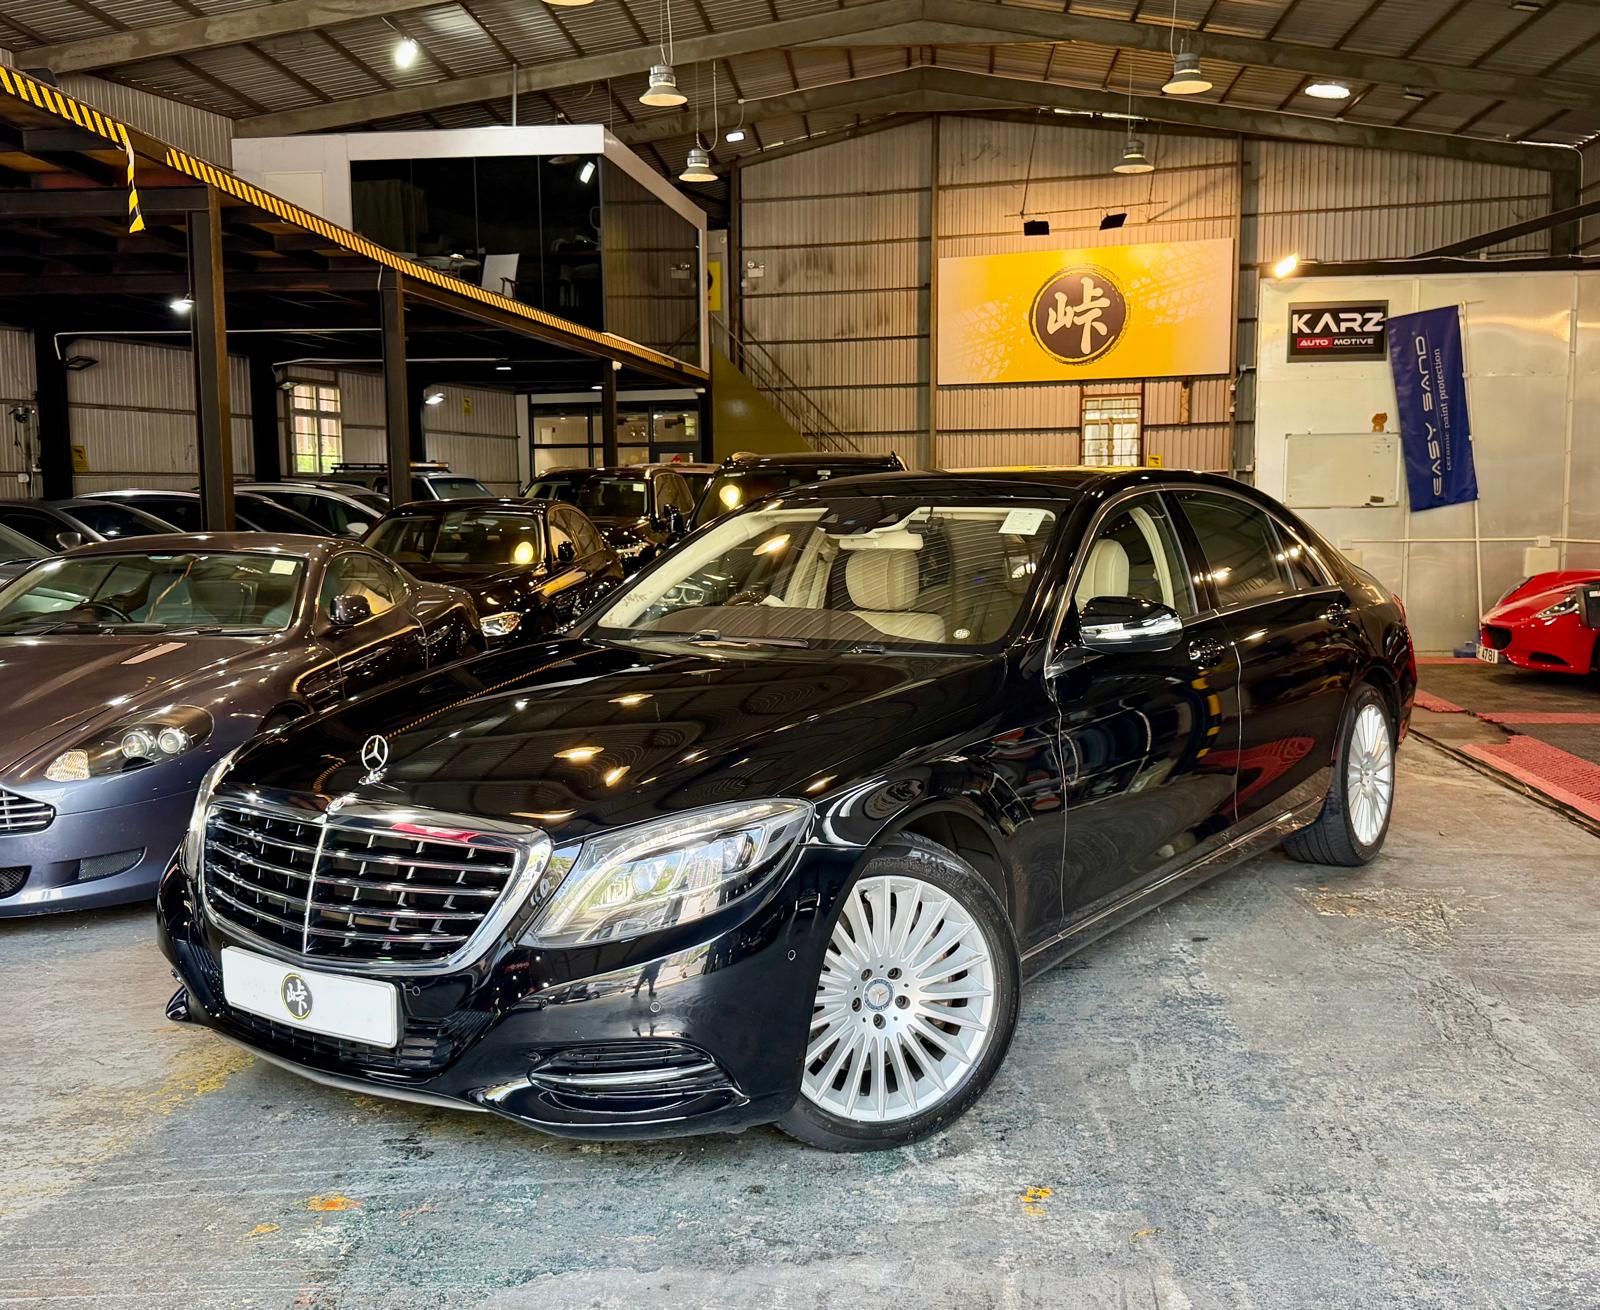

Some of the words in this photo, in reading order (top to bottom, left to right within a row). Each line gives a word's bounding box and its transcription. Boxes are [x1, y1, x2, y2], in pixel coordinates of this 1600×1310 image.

[1047, 277, 1111, 354] 峠
[1292, 312, 1384, 334] KARZ
[1299, 339, 1329, 347] AUTO
[1415, 336, 1433, 412] SAND
[1434, 348, 1449, 400] protection
[1440, 403, 1451, 429] paint
[1425, 422, 1442, 496] EASY
[1444, 432, 1452, 471] ceramic
